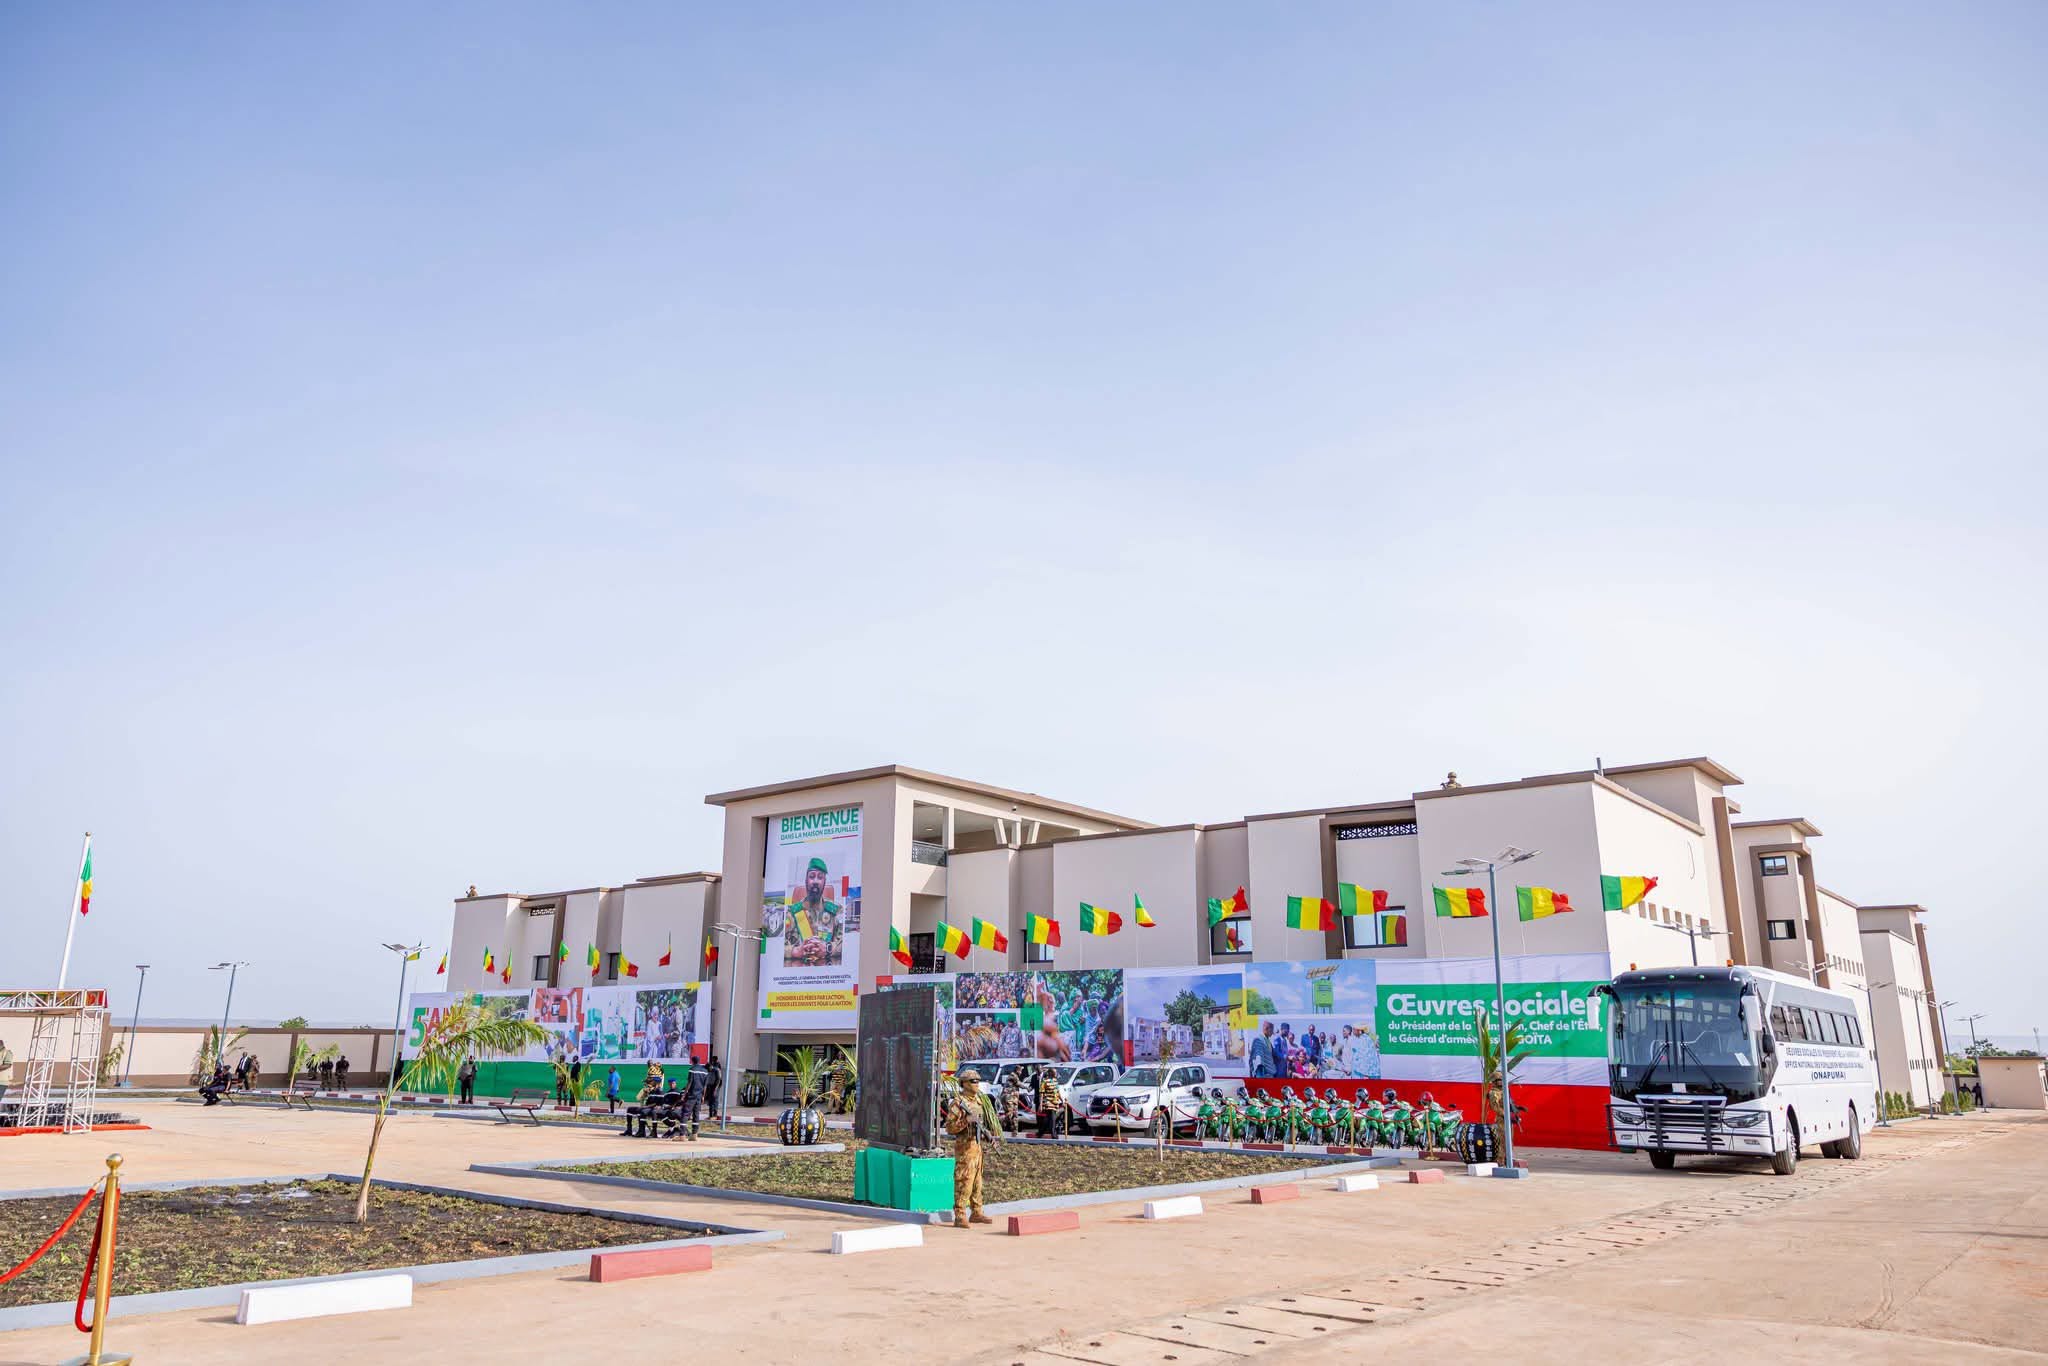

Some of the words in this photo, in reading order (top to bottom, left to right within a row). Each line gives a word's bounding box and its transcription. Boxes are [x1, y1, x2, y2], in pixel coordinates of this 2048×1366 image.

[781, 808, 859, 832] BIENVENUE
[803, 830, 823, 838] MAISON
[1387, 993, 1486, 1016] Œuvres
[1491, 990, 1586, 1016] sociale
[1388, 1021, 1400, 1030] du
[1402, 1021, 1446, 1030] Président
[1448, 1021, 1461, 1030] de
[1462, 1020, 1472, 1030] la
[1529, 1020, 1555, 1031] Chef
[1555, 1020, 1570, 1031] de
[1388, 1033, 1397, 1043] le
[1399, 1034, 1437, 1043] Général
[1811, 1071, 1847, 1080] (ONAPUMA)
